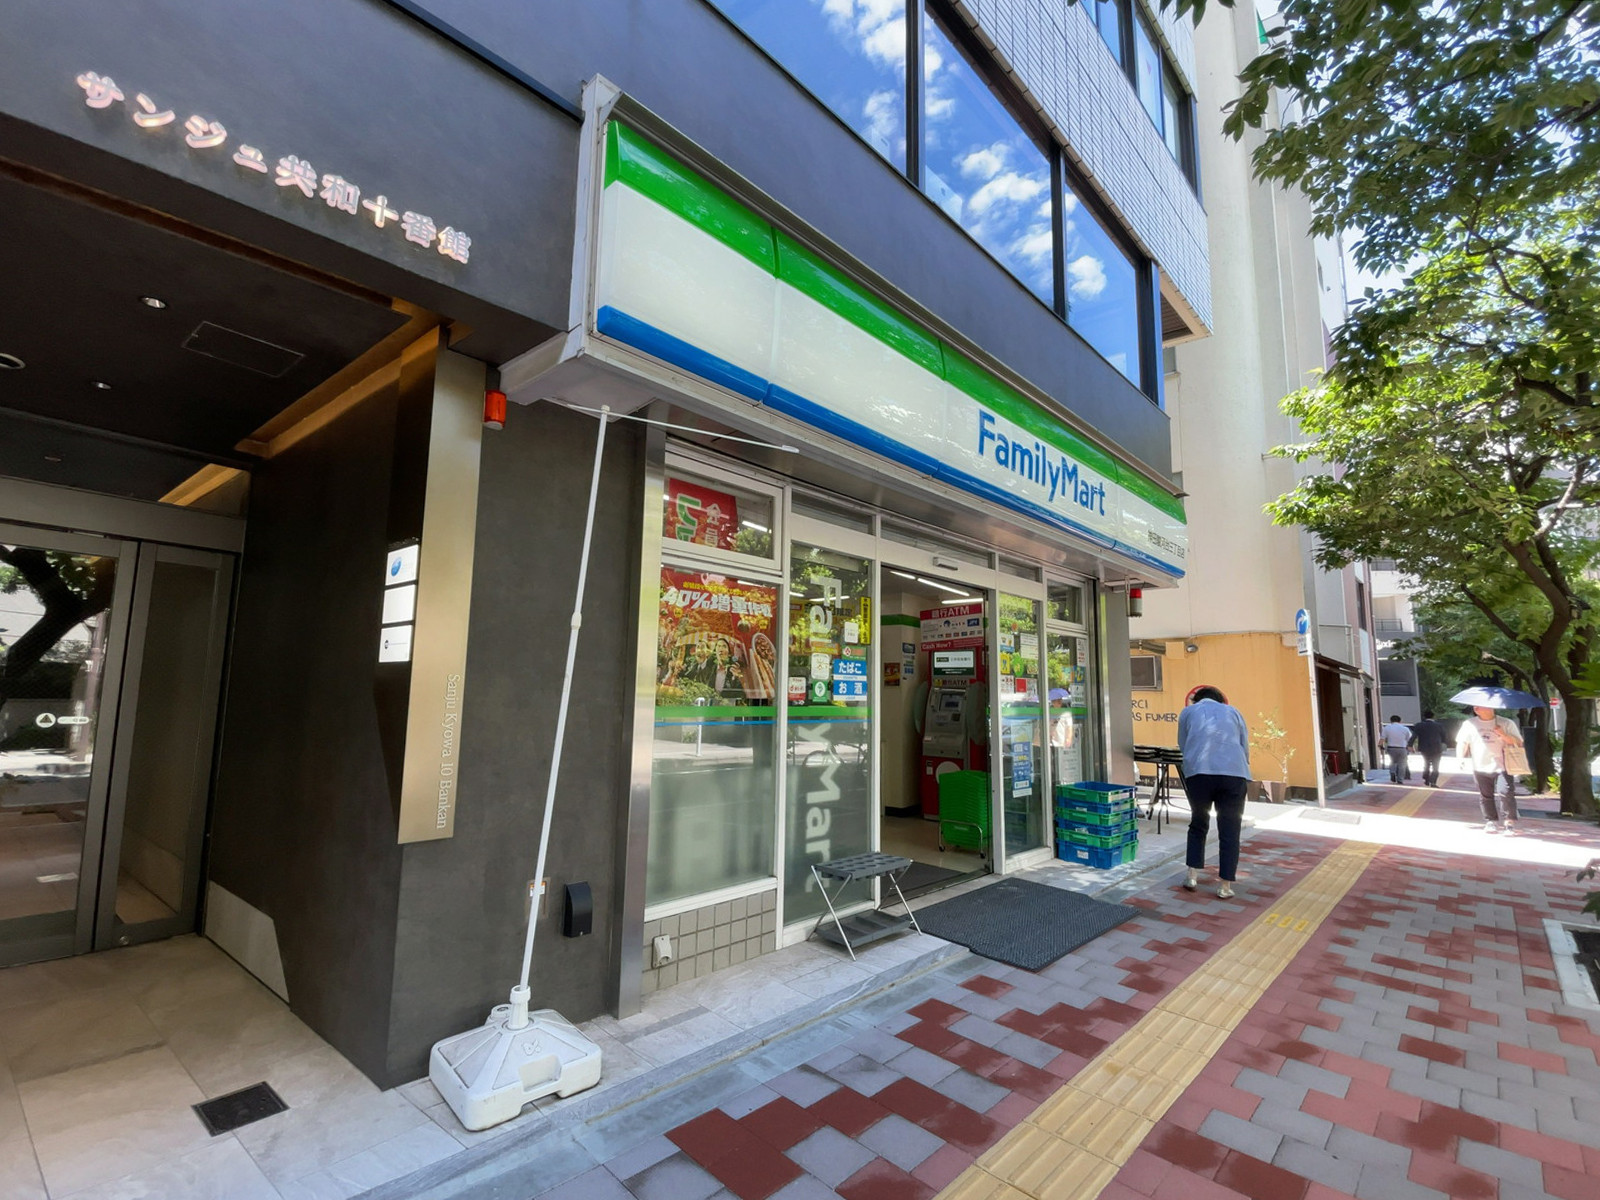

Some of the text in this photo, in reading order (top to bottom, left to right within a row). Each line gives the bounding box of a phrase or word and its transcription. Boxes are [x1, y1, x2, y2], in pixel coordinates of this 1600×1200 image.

[76, 70, 473, 265] サンジュ共和十番館
[978, 409, 1105, 517] FamilyMart
[838, 661, 862, 674] たばこ
[444, 673, 461, 709] Sanju
[441, 713, 458, 757] Kyowa
[1145, 712, 1178, 723] FUMER
[436, 780, 452, 829] Bankan
